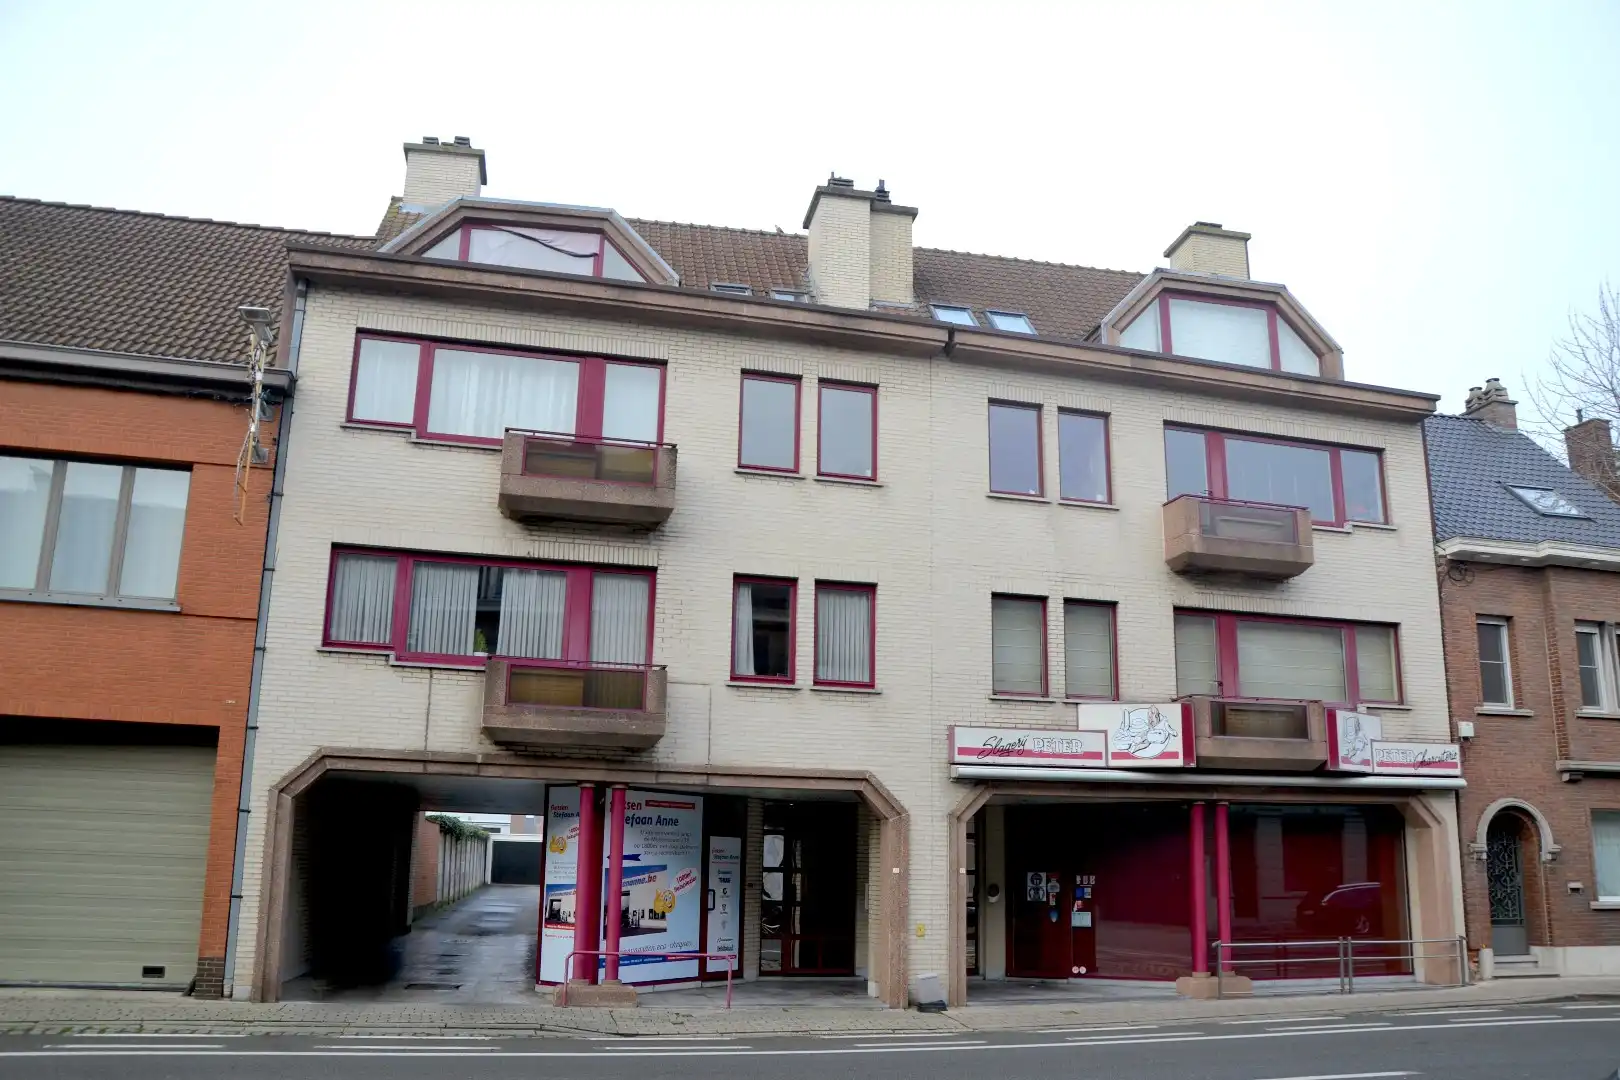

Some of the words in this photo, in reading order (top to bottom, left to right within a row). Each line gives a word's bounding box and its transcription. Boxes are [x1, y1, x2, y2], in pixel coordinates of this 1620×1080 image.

[1032, 737, 1083, 755] PETER
[1374, 748, 1416, 763] PETER
[1413, 749, 1458, 770] Charcuterie
[624, 813, 653, 828] efaan
[655, 814, 679, 827] Anne
